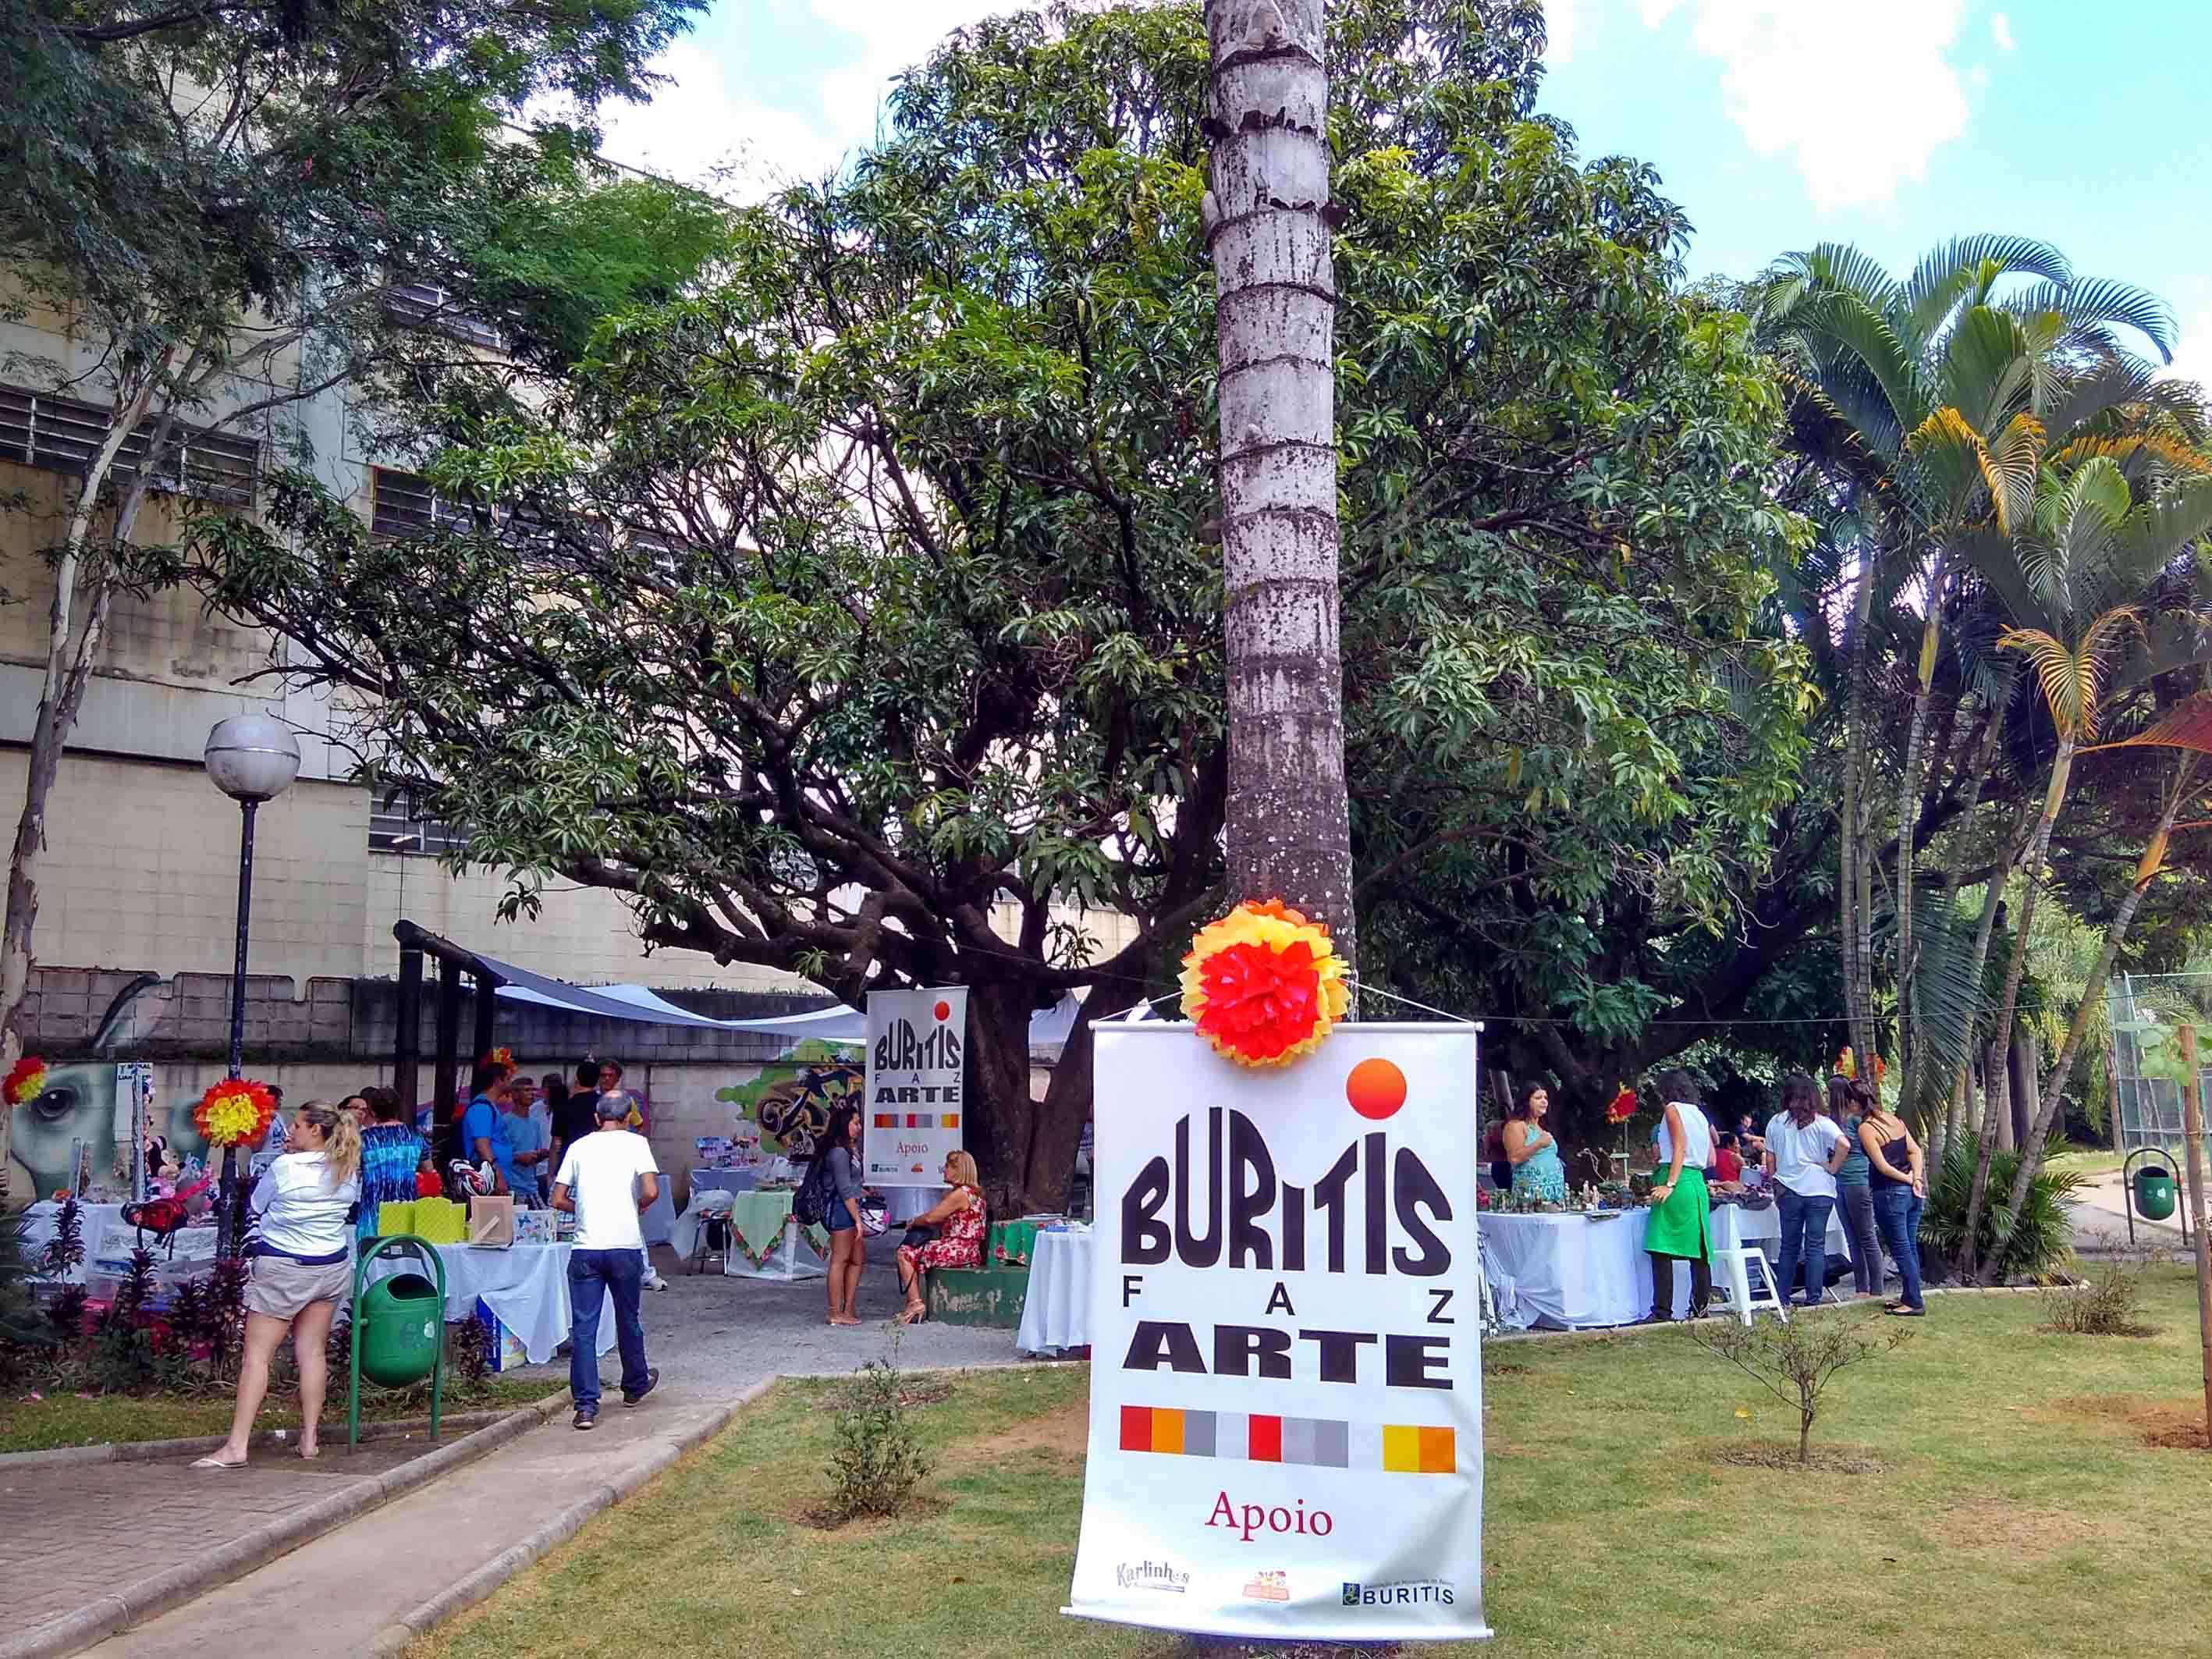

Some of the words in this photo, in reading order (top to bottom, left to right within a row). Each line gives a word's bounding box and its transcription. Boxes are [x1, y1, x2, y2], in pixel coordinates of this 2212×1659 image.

[874, 1018, 961, 1070] BURITIS
[875, 1086, 960, 1103] ARTE
[897, 1142, 928, 1157] Apoio
[1121, 1106, 1454, 1277] BURITIS
[1122, 1320, 1454, 1390] ARTE
[1205, 1491, 1333, 1542] Apoio
[1363, 1586, 1455, 1604] BURITIS
